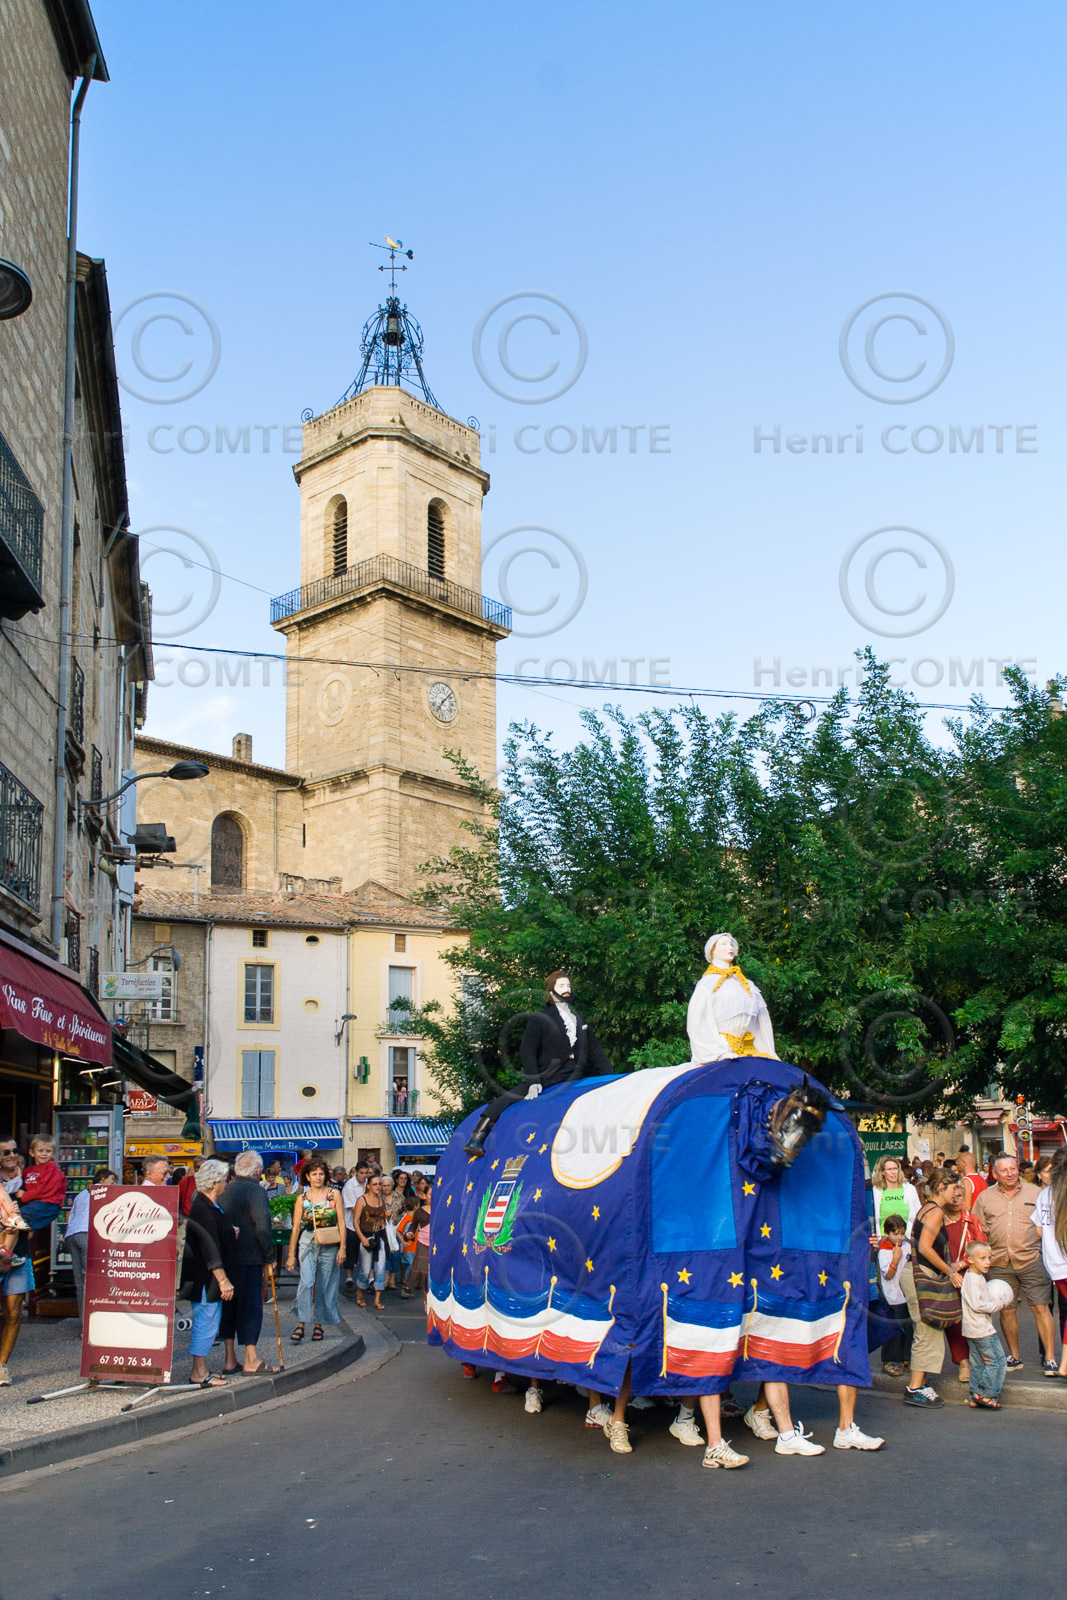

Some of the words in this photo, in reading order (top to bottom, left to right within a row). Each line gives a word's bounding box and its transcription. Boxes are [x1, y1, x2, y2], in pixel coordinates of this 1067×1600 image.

[2, 984, 27, 1013] Vins
[31, 997, 53, 1024] Fins
[57, 1015, 66, 1030] et
[109, 1249, 125, 1257] Vins
[108, 1259, 146, 1268] Spiritueux
[107, 1270, 160, 1280] Champagnes
[109, 1286, 150, 1297] Livraisons
[100, 1355, 110, 1364] 67
[113, 1356, 124, 1365] 90
[127, 1356, 138, 1366] 76
[141, 1357, 152, 1367] 34
